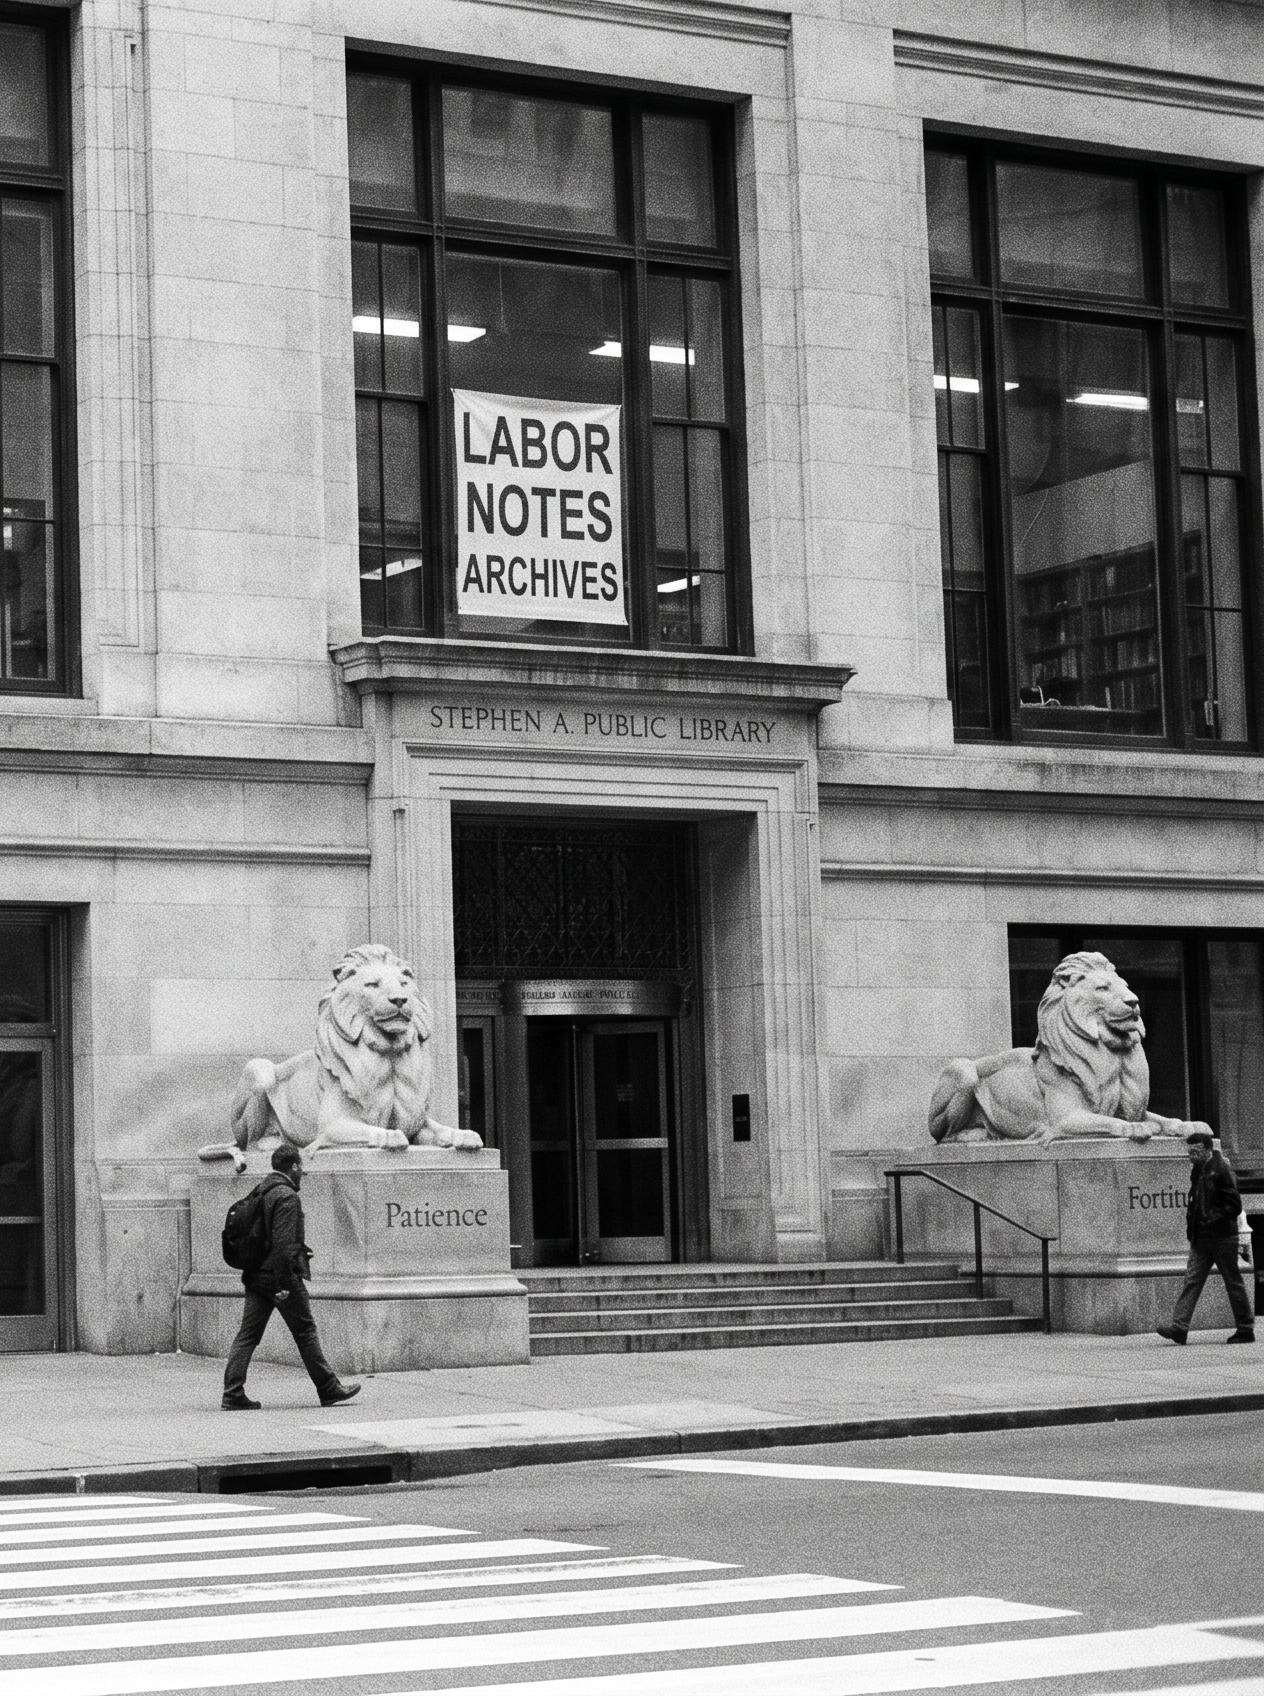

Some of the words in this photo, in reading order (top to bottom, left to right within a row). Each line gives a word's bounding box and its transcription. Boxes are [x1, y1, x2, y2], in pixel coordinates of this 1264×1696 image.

[463, 411, 613, 475] LABOR
[466, 481, 613, 543] NOTES
[462, 553, 619, 602] ARCHIVES
[430, 705, 541, 733] STEPHEN
[552, 711, 575, 735] A.
[584, 712, 667, 740] PUBLIC
[679, 717, 777, 744] LIBRARY
[385, 1202, 488, 1228] Patience
